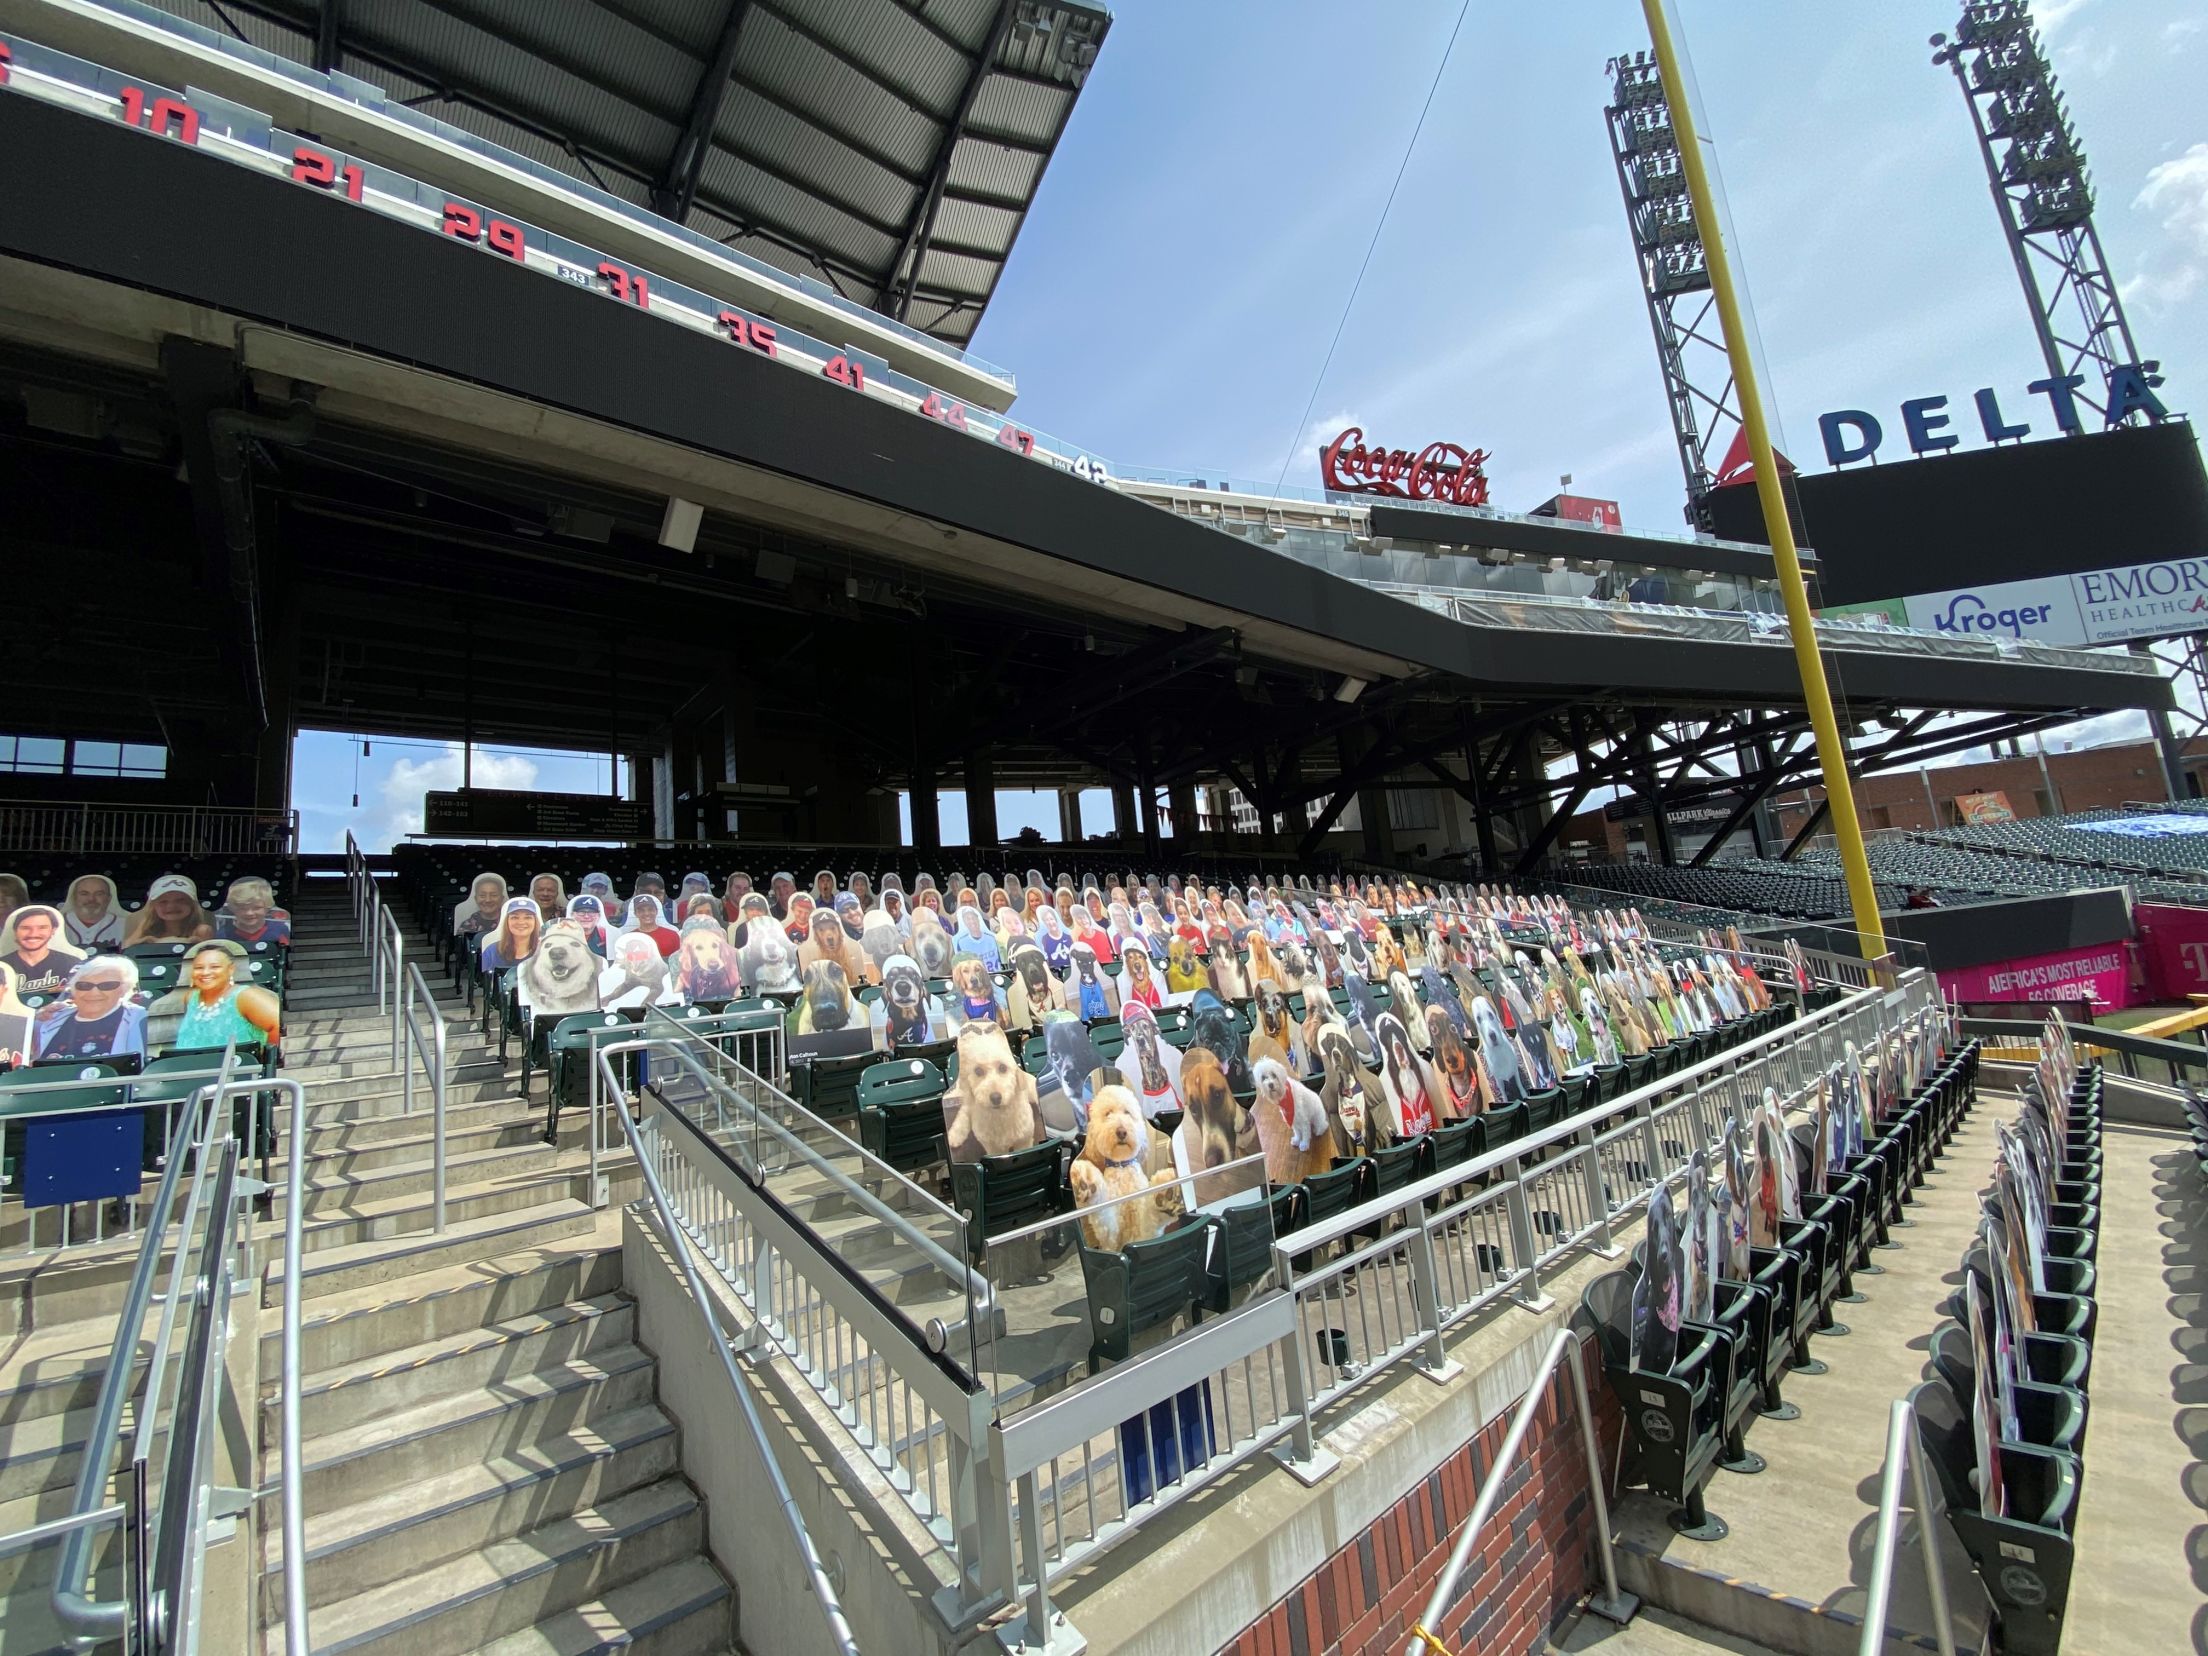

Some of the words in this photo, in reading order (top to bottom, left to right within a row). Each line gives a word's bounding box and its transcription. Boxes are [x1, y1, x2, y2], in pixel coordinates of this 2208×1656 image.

[121, 87, 199, 145] 10
[293, 148, 364, 203] 21
[443, 203, 524, 262] 29
[561, 269, 587, 285] 343
[597, 263, 649, 309] 31
[719, 310, 777, 358] 35
[823, 355, 864, 391] 41
[920, 393, 968, 432] 44
[1818, 364, 2169, 465] DELTA
[998, 424, 1035, 457] 47
[1073, 455, 1108, 486] 42
[1324, 427, 1492, 507] Coca-Cola
[2079, 560, 2208, 604] EMOR
[1934, 594, 2051, 638] Kroger
[1667, 809, 1704, 821] ALLPARK
[2048, 961, 2075, 983] MOST
[2075, 953, 2121, 977] RELIABLE
